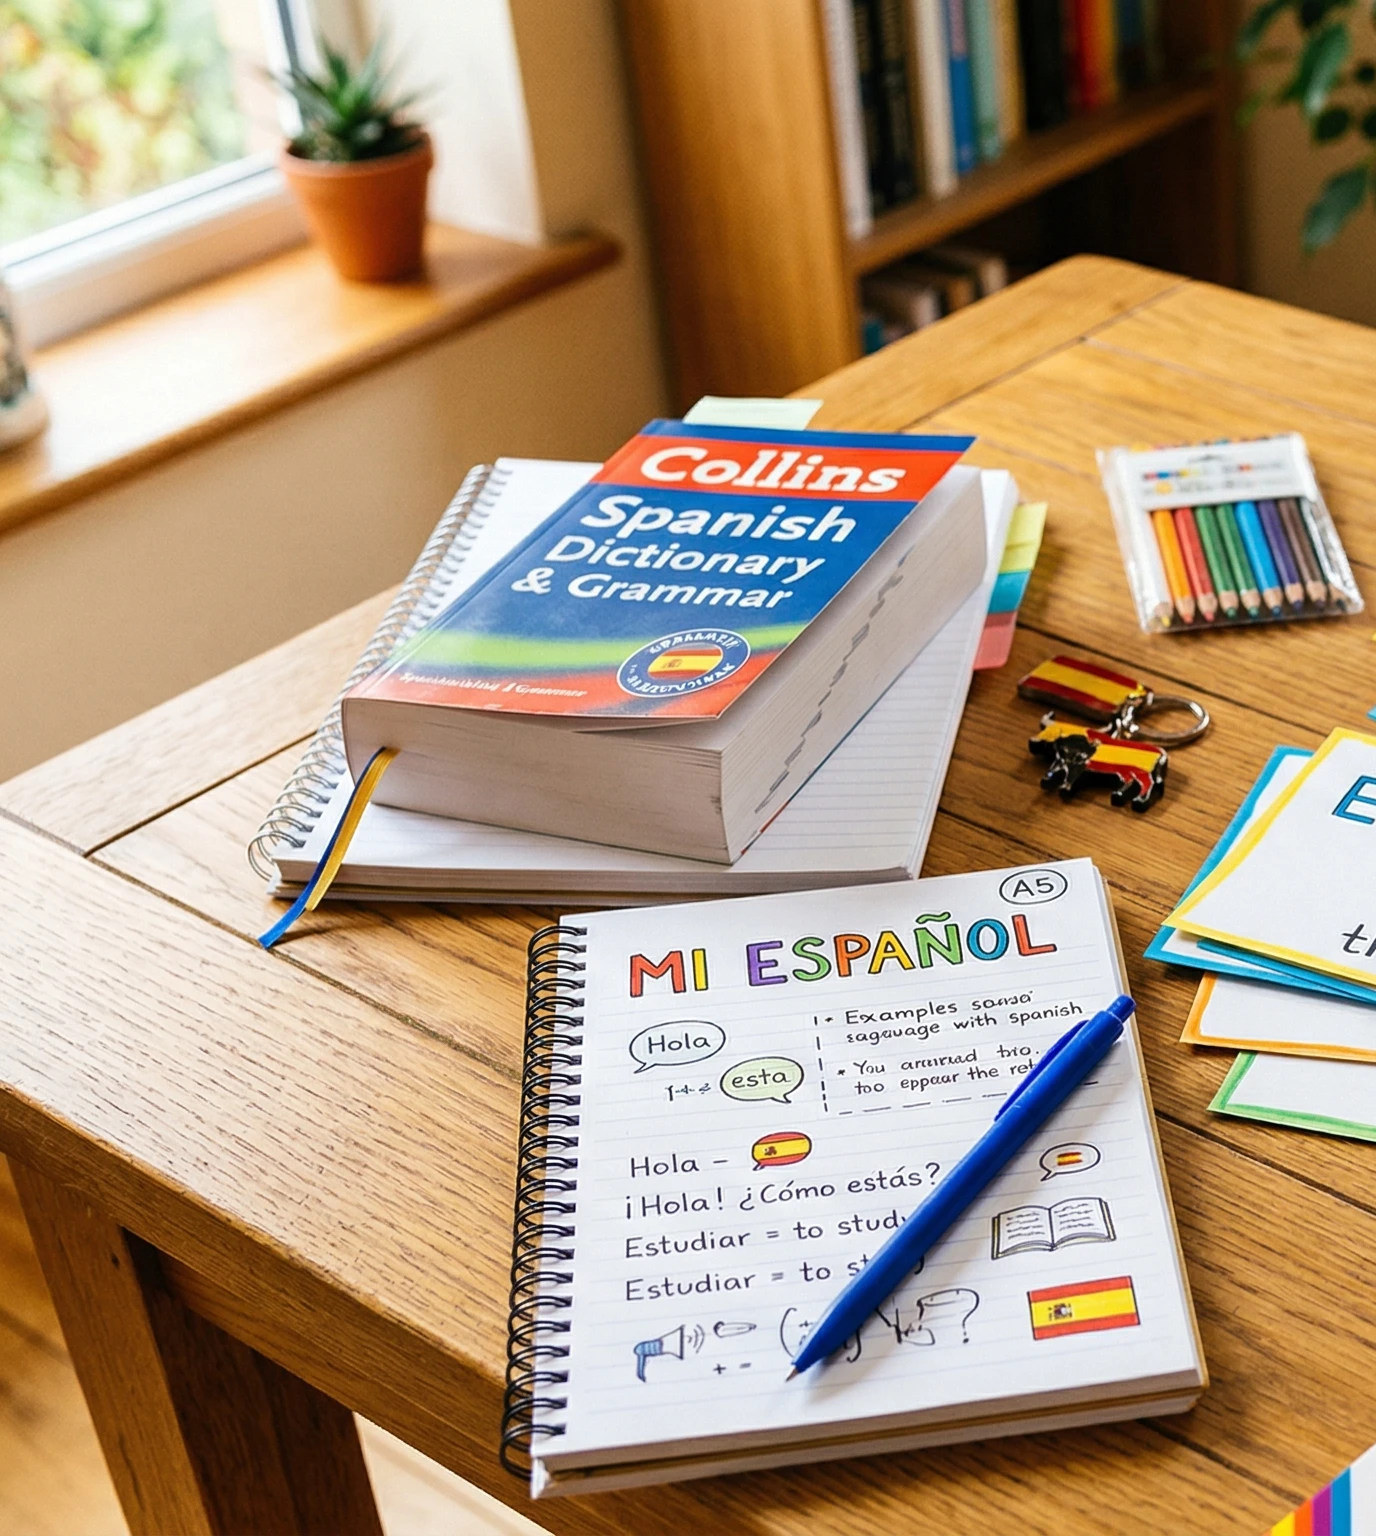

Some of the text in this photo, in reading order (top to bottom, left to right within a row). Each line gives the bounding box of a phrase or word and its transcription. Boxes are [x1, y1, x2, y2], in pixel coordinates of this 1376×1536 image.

[640, 446, 906, 493] Collins
[580, 496, 856, 543] Spanish
[544, 535, 825, 584] Dictionary
[511, 567, 793, 608] & Grammar
[1012, 875, 1055, 899] A5
[629, 911, 1057, 998] MI ESPAÑOL
[845, 1001, 957, 1025] Examples
[953, 1012, 997, 1031] with
[1008, 1001, 1083, 1026] spanish
[648, 1033, 711, 1054] Hola
[731, 1068, 791, 1089] esta
[853, 1060, 886, 1076] You
[967, 1066, 999, 1081] the
[630, 1153, 700, 1178] Hola
[626, 1162, 941, 1220] ¡Hola! ¿Cómo estás?
[625, 1230, 751, 1259] Estudiar
[793, 1221, 823, 1240] to
[626, 1272, 757, 1301] Estudiar
[800, 1262, 831, 1282] to
